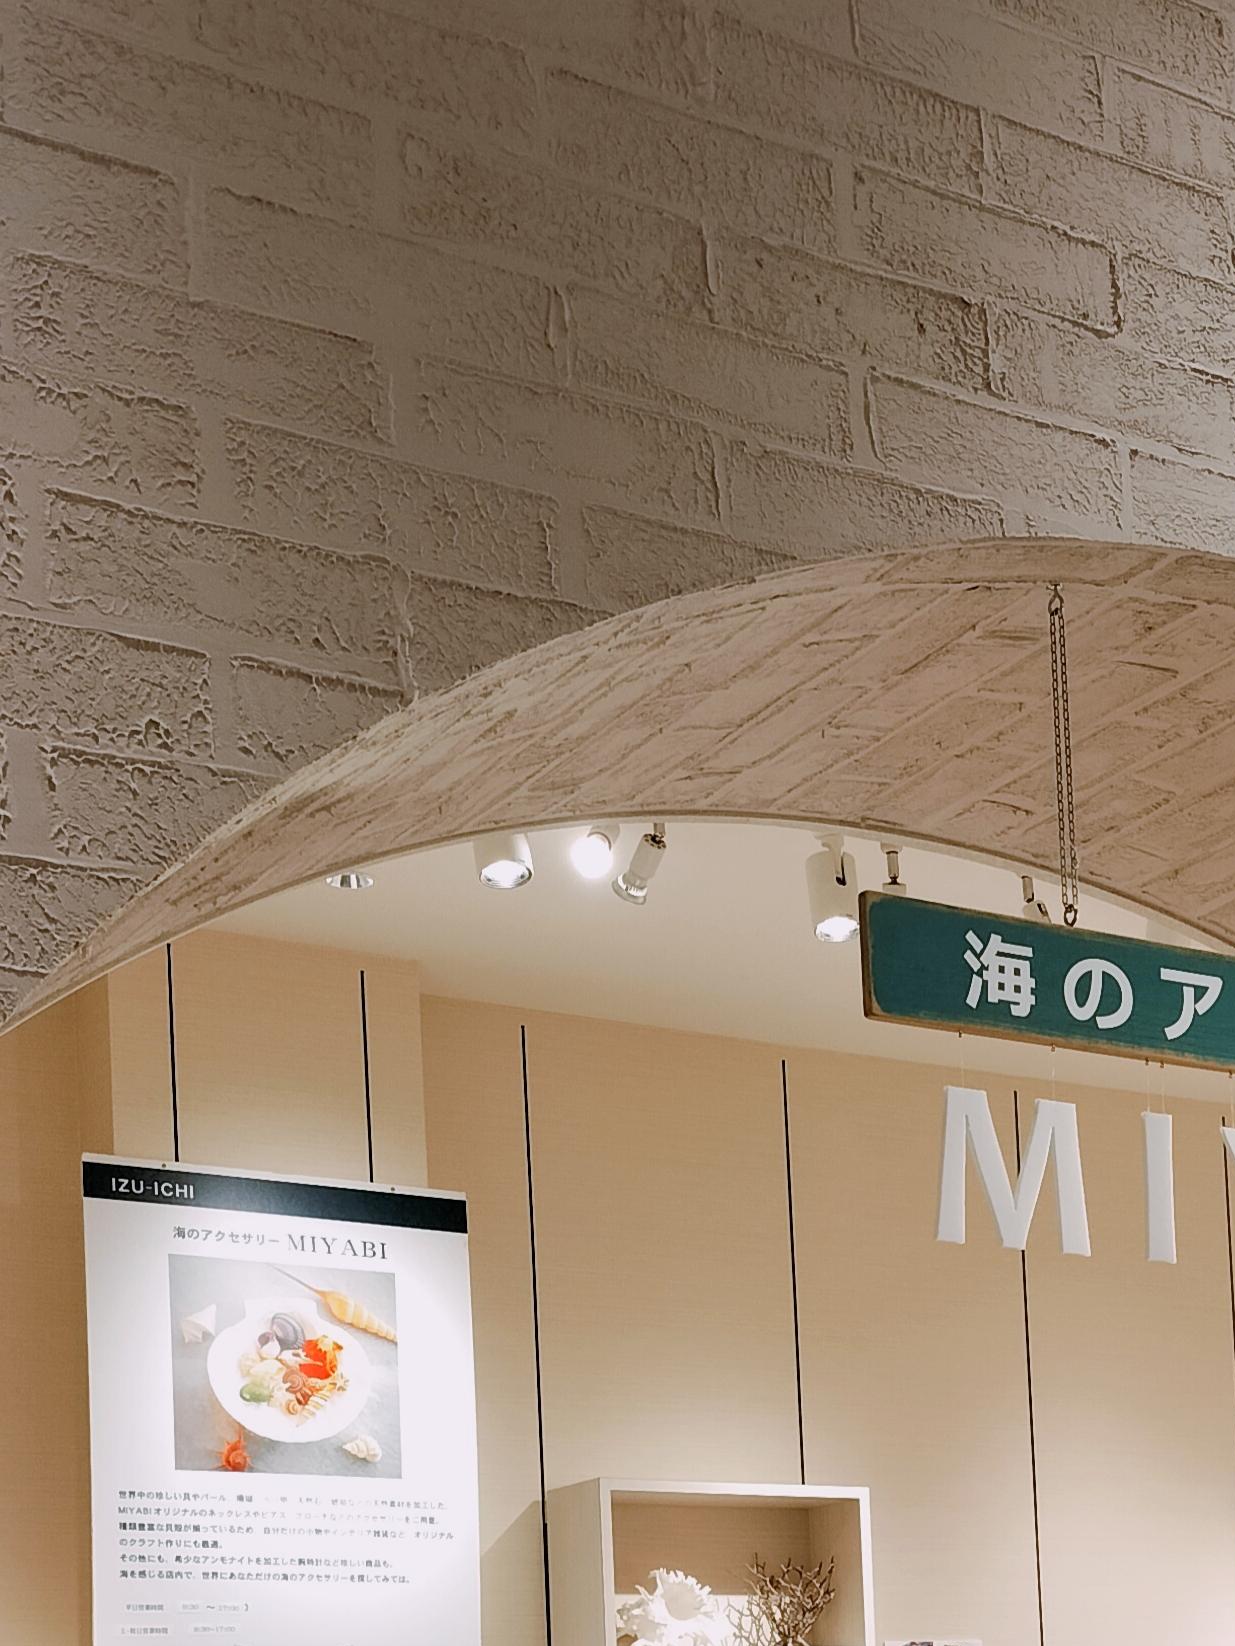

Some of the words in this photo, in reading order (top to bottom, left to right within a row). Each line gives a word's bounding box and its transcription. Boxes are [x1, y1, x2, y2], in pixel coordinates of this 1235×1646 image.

[111, 1178, 194, 1199] IZU-ICHI
[173, 1225, 280, 1245] 海のアクセサリー
[287, 1234, 387, 1260] MIYABI
